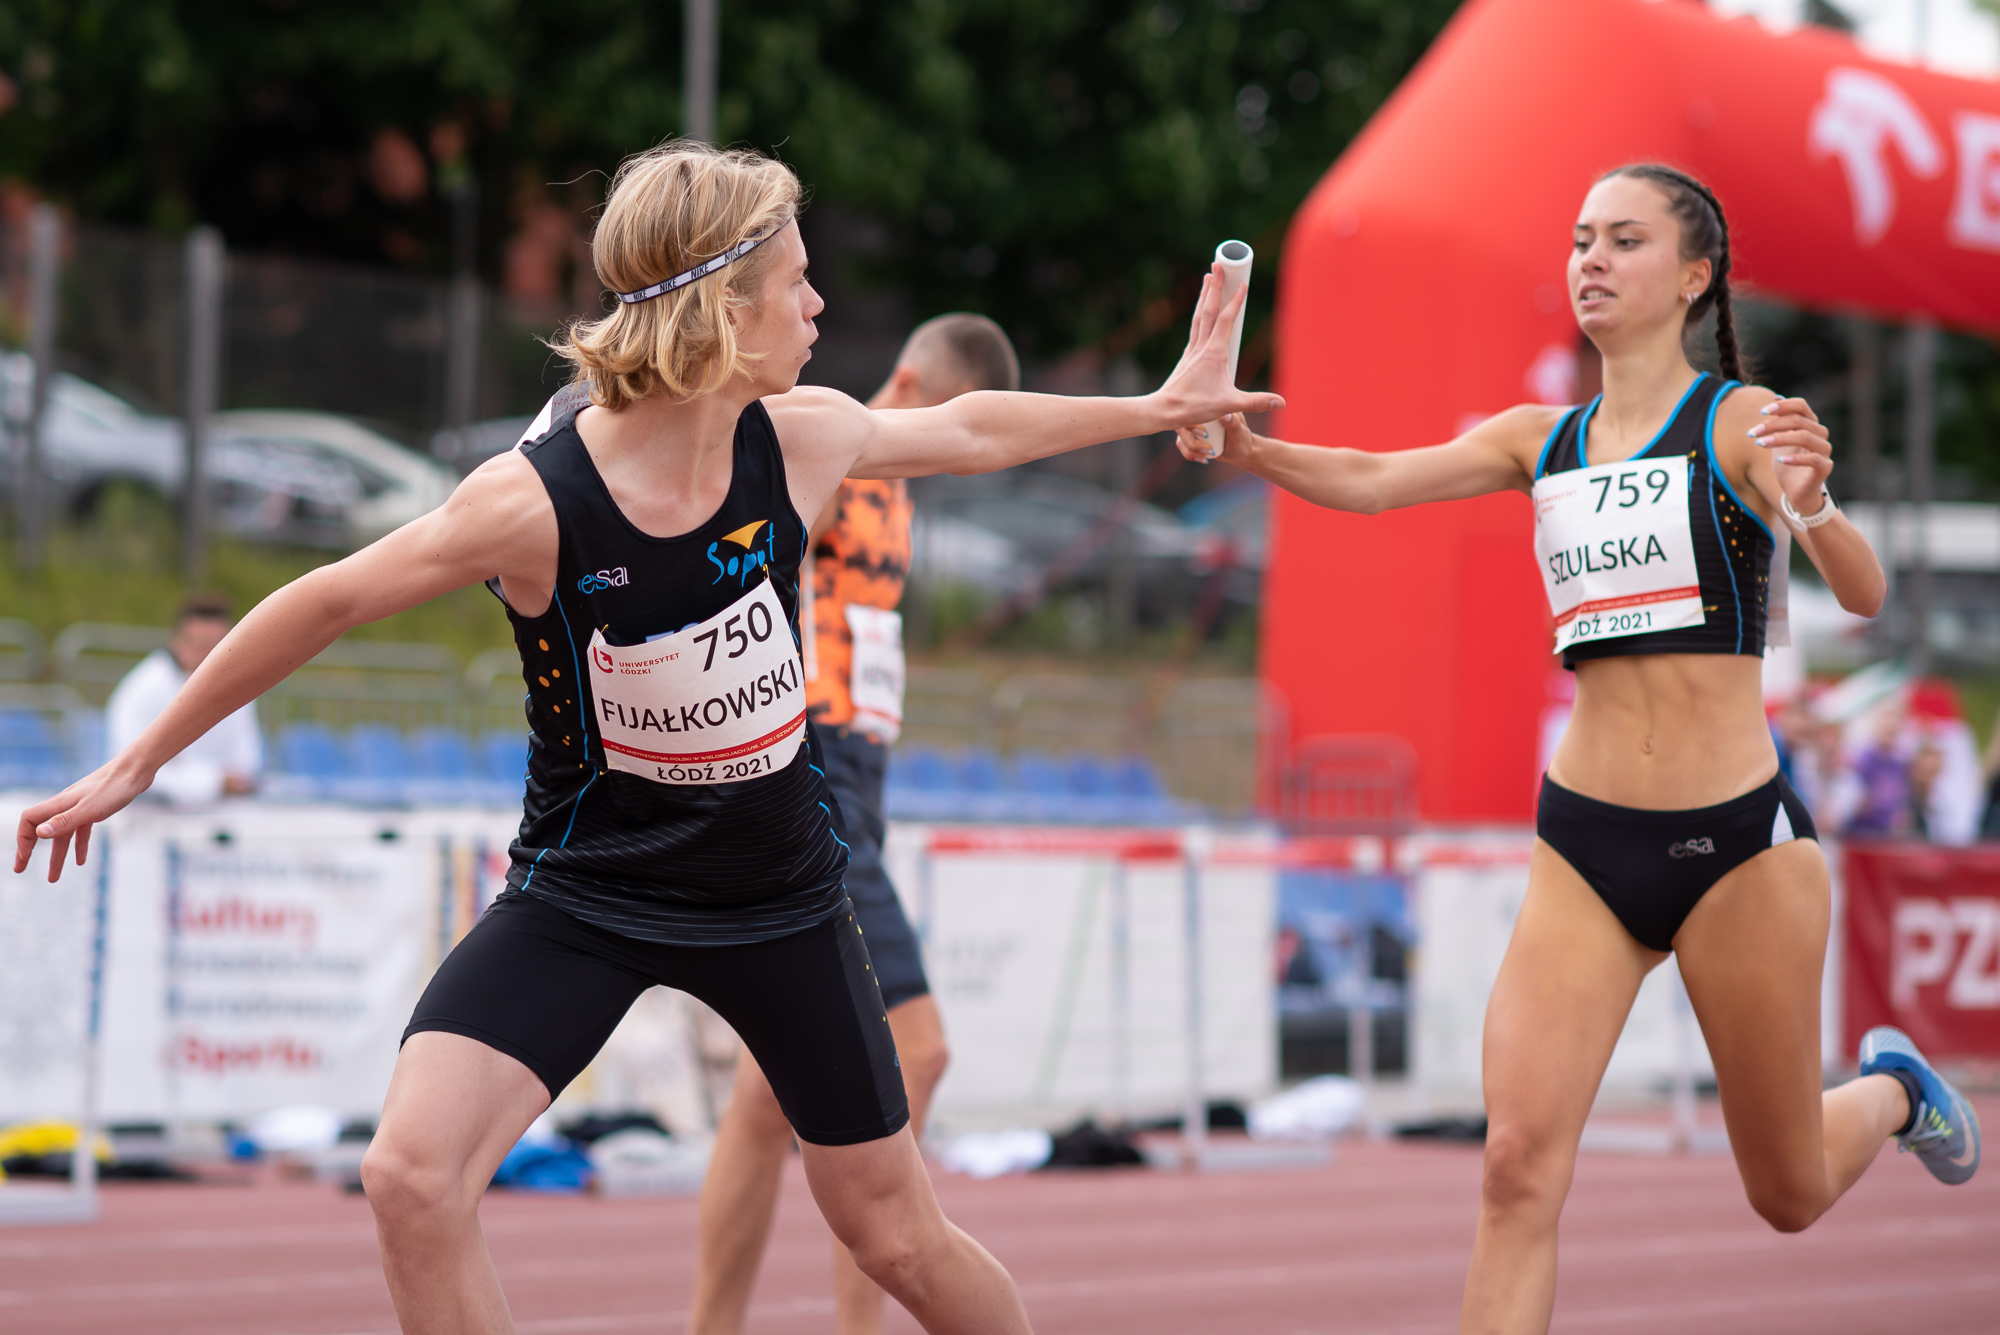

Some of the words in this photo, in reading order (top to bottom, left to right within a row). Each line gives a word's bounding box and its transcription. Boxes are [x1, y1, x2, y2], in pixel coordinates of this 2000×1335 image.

[633, 289, 648, 301] NIKE
[659, 277, 677, 294] NIKE
[690, 262, 710, 280] NIKE
[1589, 469, 1670, 514] 759
[707, 522, 775, 588] Sopot
[1549, 534, 1668, 585] SZULSKA
[577, 566, 630, 594] esa
[693, 601, 773, 673] 750
[1608, 611, 1652, 633] 2021
[618, 652, 680, 668] UNIWERSYTET
[600, 658, 799, 734] FIJAŁKOWSKI
[656, 763, 716, 782] ŁÓDŹ
[722, 754, 772, 779] 2021
[700, 748, 746, 760] WIELOBOJACH
[1668, 837, 1716, 859] esa
